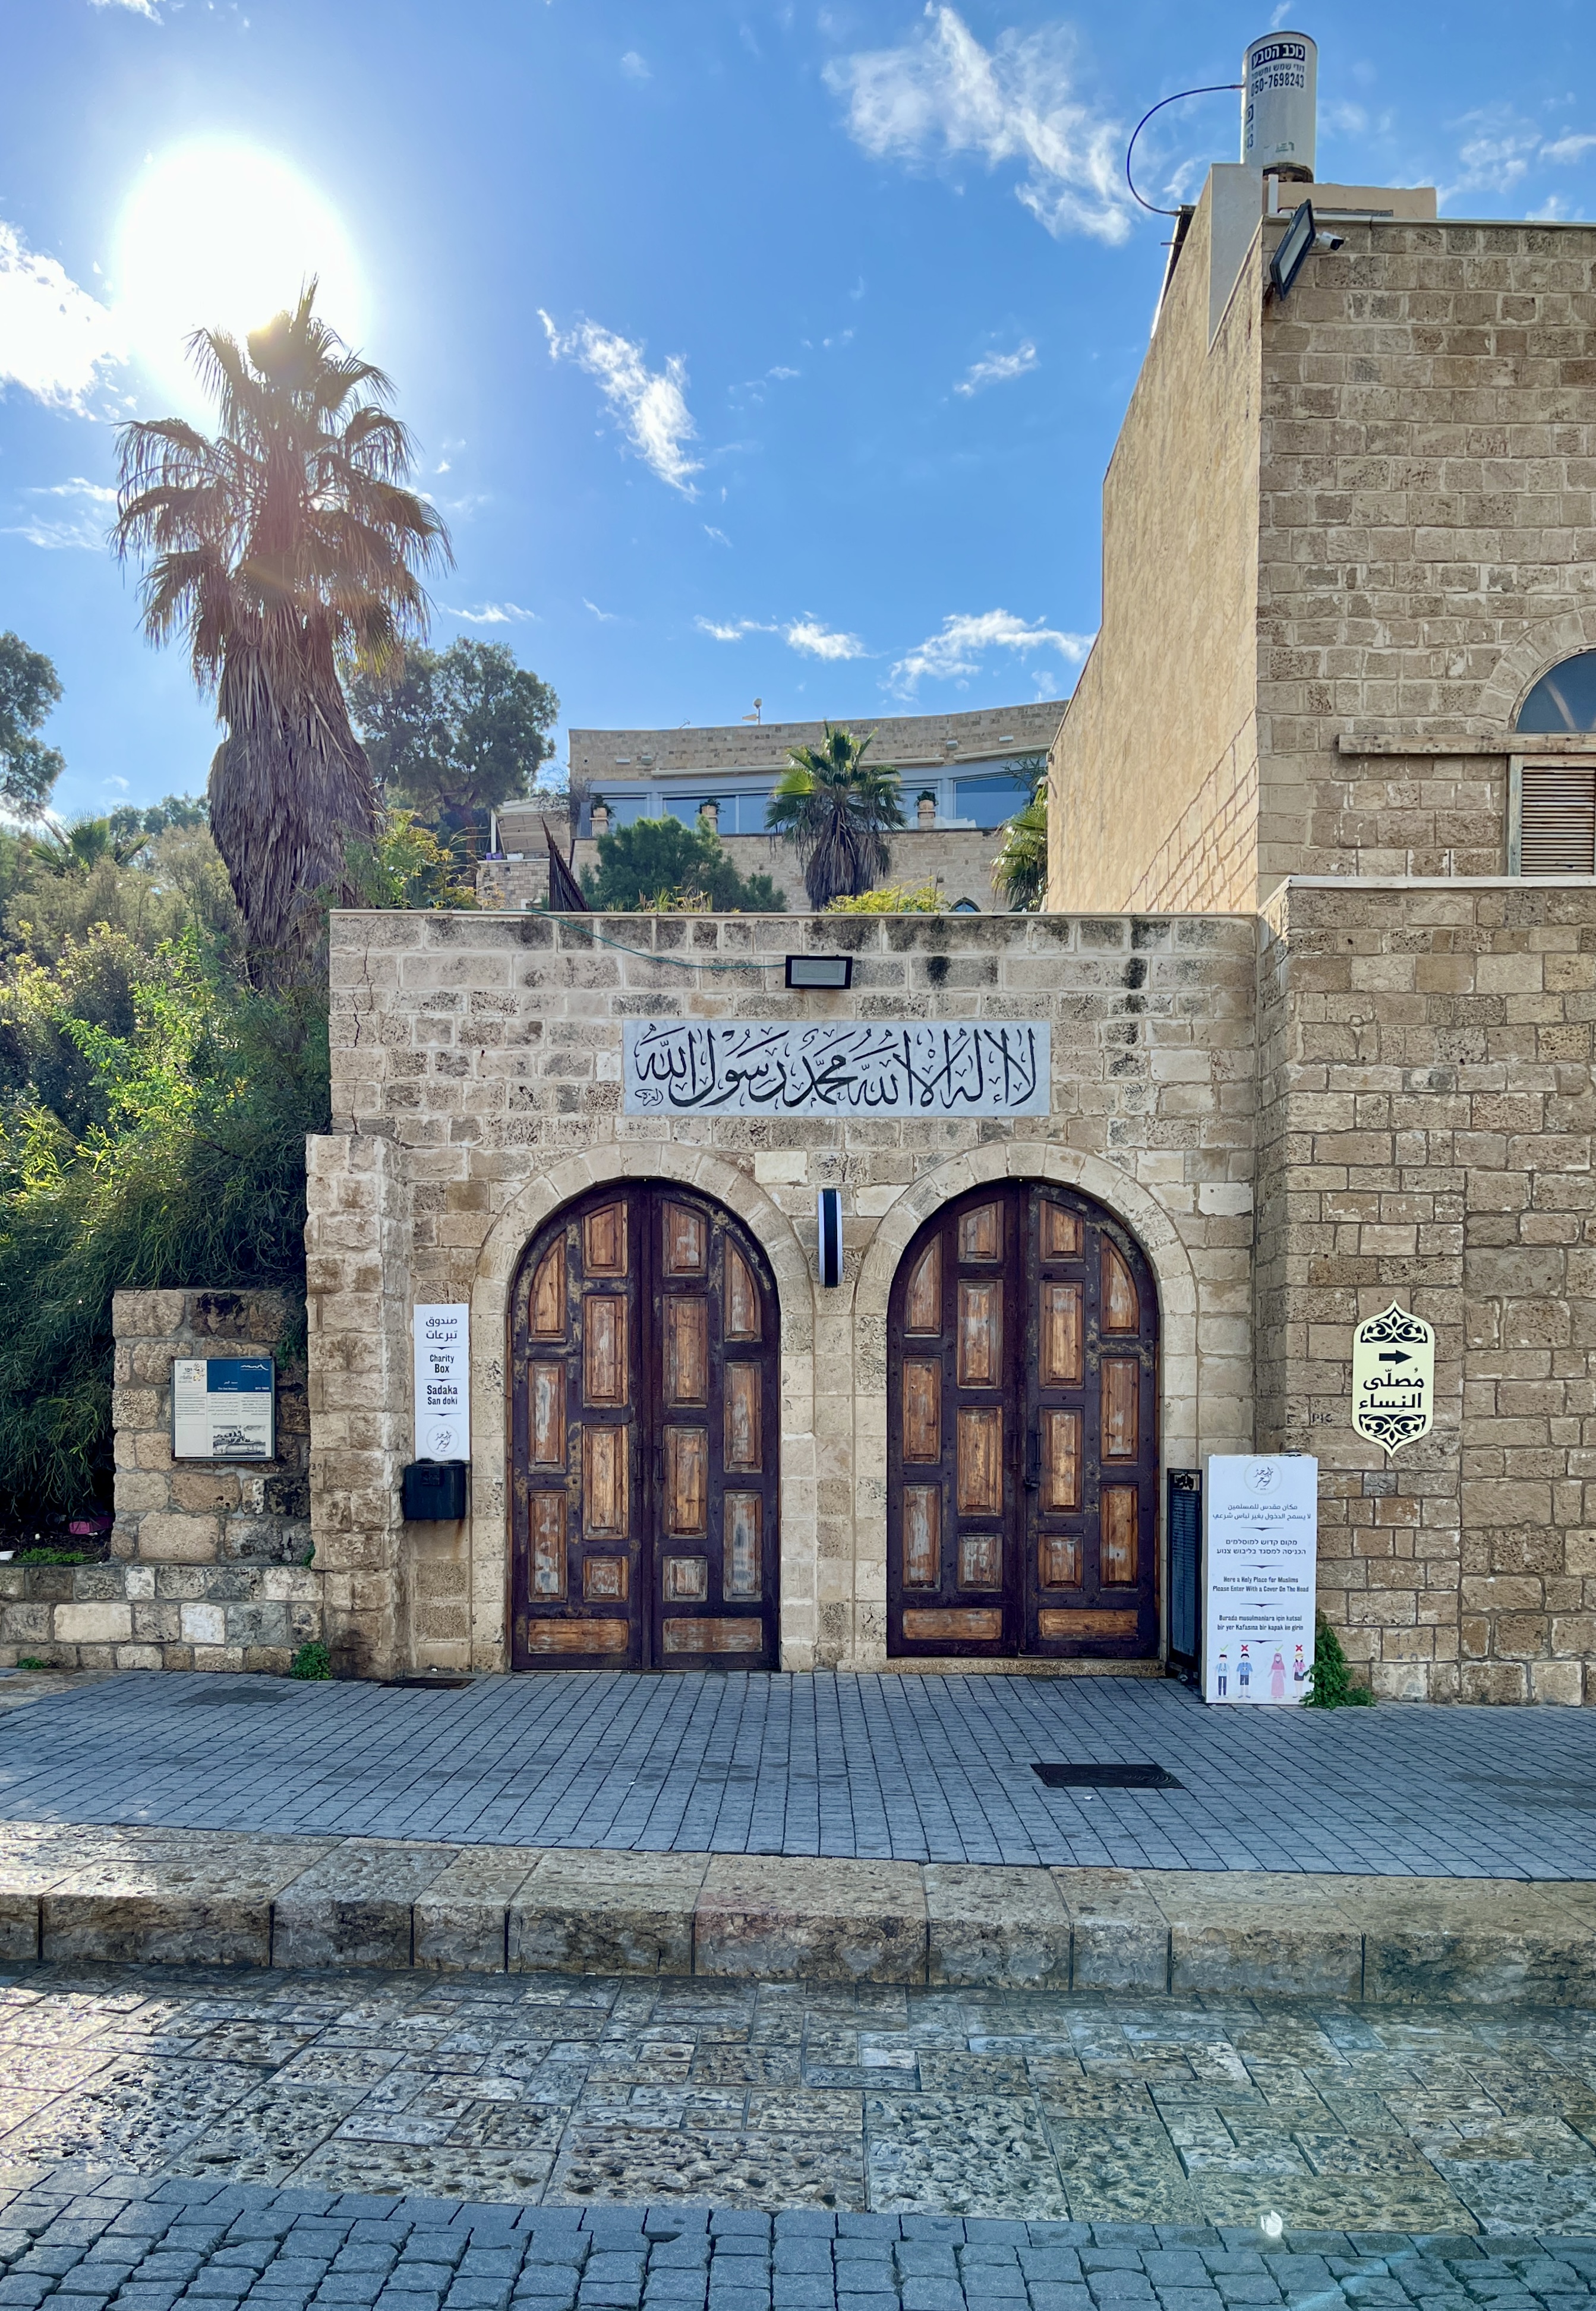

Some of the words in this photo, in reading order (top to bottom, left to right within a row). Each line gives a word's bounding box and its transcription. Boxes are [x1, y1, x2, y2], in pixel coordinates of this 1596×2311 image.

[1273, 63, 1292, 71] שמש
[1251, 72, 1304, 97] 050-7698243
[635, 1026, 696, 1095] الله
[847, 1029, 913, 1106] الله
[983, 1027, 1036, 1106] لا
[426, 1317, 458, 1326] صندوق
[426, 1330, 458, 1342] تبرعات
[430, 1354, 454, 1364] Charity
[435, 1364, 449, 1373] Box
[427, 1385, 458, 1395] Sadaka
[443, 1396, 458, 1405] doki
